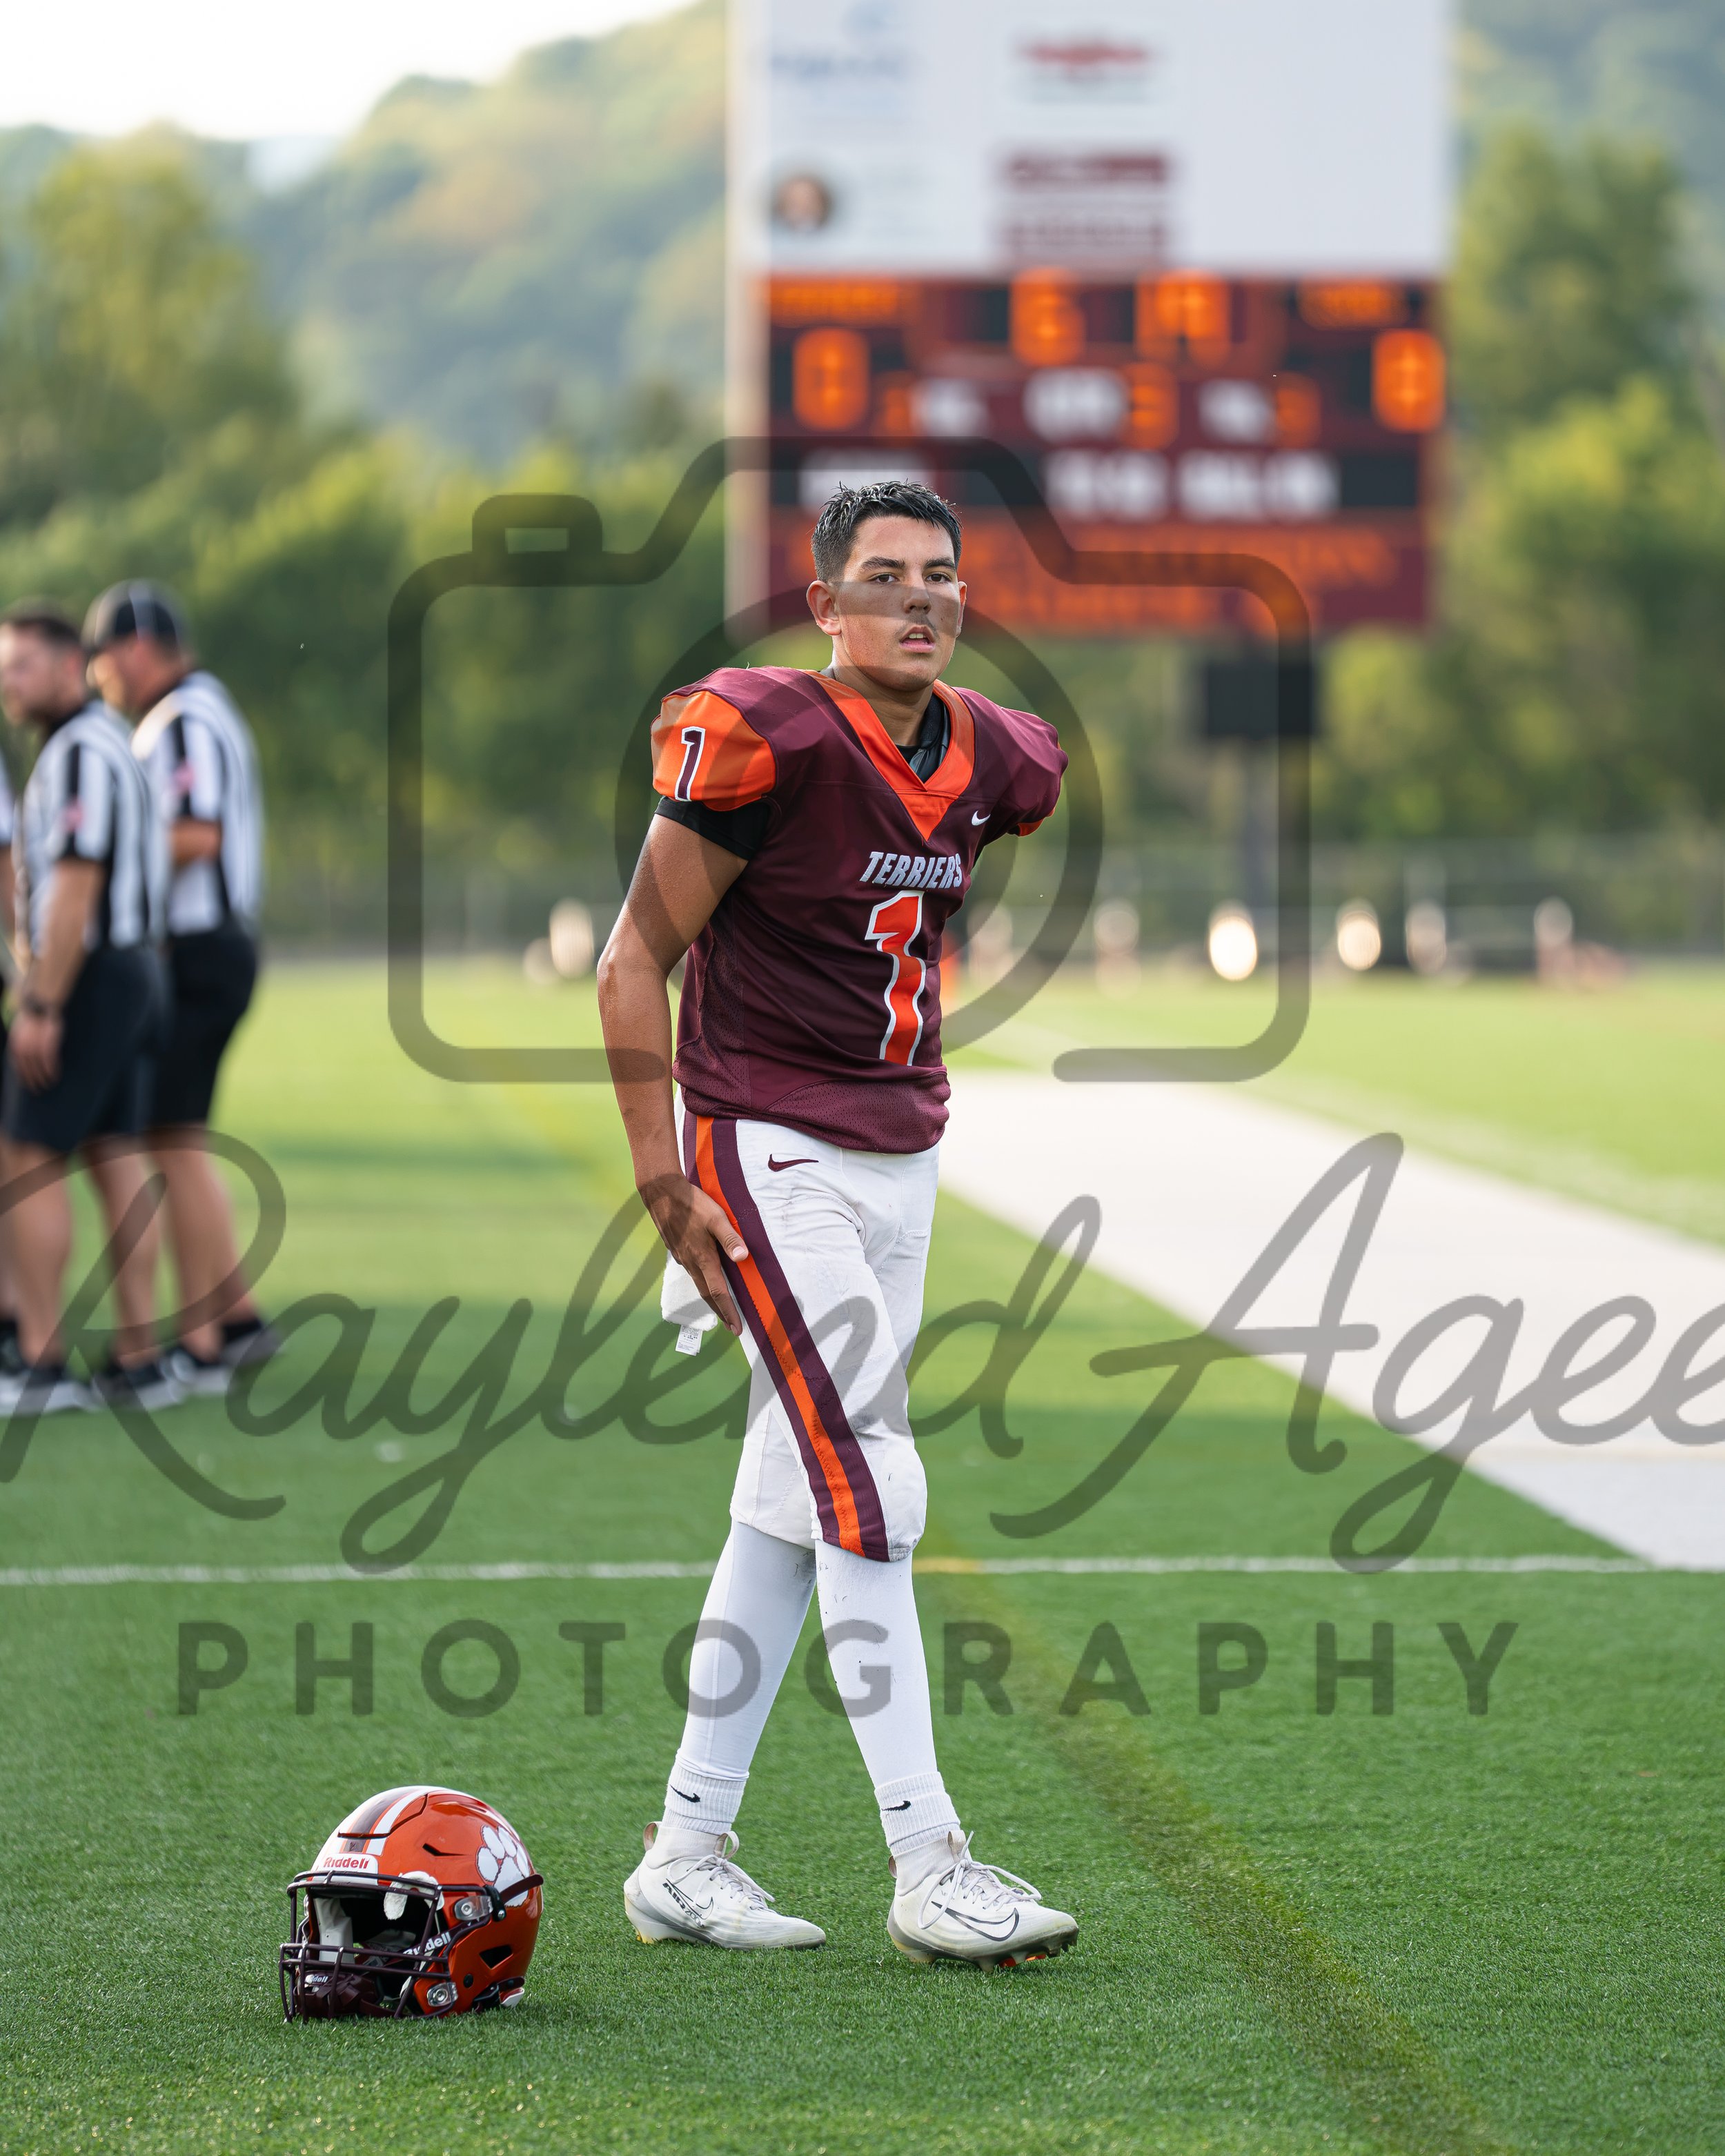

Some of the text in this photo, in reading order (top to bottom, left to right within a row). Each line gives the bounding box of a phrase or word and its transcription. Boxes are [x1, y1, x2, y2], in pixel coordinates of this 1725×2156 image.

[674, 726, 705, 801] 1
[860, 851, 963, 889] TERRIERS
[865, 889, 927, 1067] 1
[323, 1857, 370, 1869] Riddell
[662, 1882, 686, 1910] AIR
[402, 1931, 452, 1956] Ridell
